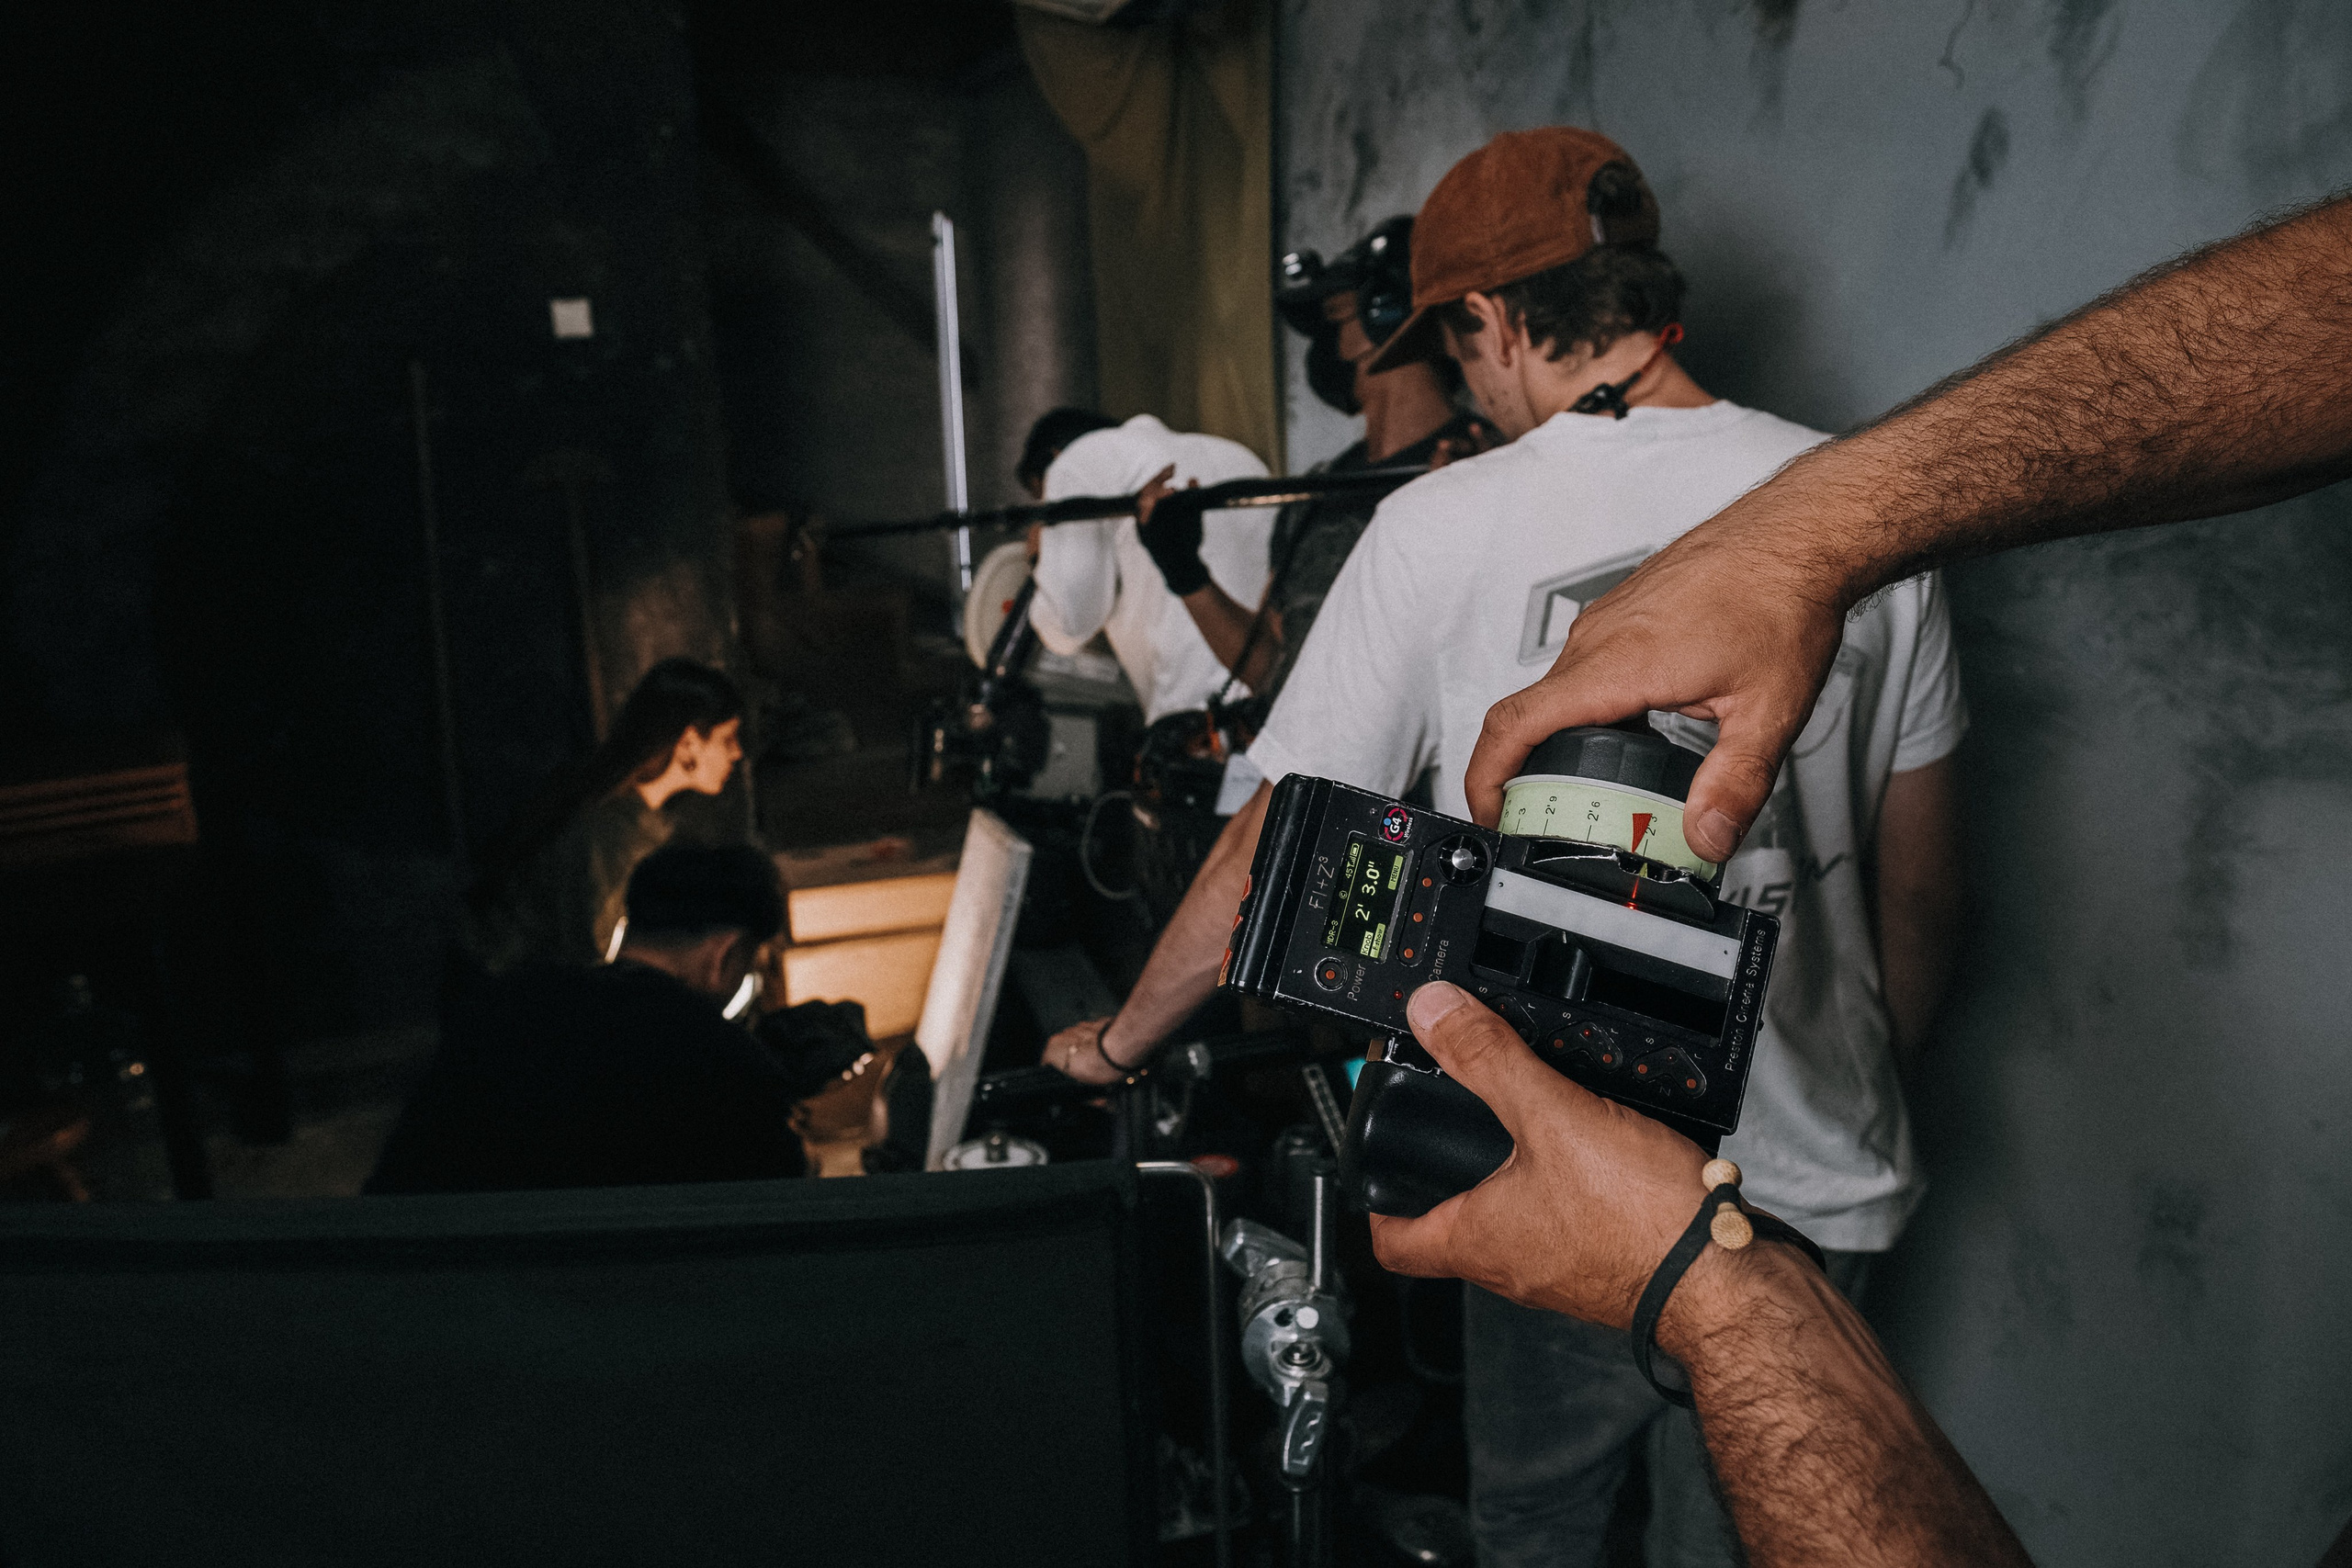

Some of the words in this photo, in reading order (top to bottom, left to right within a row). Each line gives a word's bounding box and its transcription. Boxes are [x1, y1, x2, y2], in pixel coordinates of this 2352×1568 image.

[1518, 807, 1527, 816] 3
[1389, 817, 1402, 834] G4
[1403, 817, 1414, 839] Wireless
[1390, 865, 1400, 883] MENU
[1326, 919, 1339, 945] MDR-3
[1361, 934, 1373, 954] Knob
[1347, 964, 1366, 1001] Power
[1724, 1028, 1745, 1072] Preston
[1736, 983, 1755, 1023] Cinema
[1747, 929, 1767, 976] Systems
